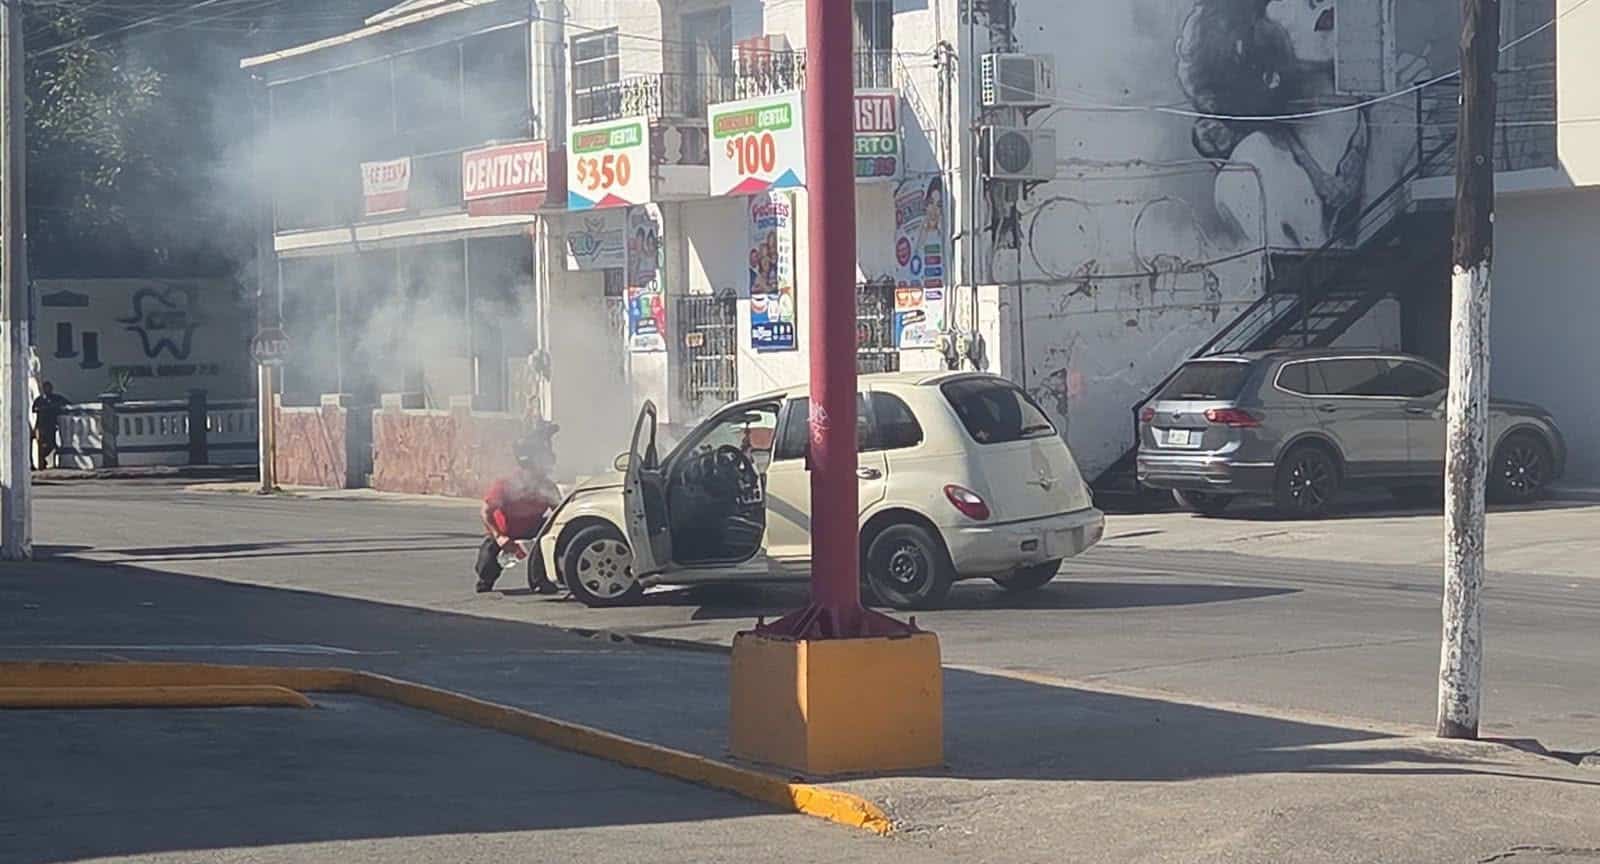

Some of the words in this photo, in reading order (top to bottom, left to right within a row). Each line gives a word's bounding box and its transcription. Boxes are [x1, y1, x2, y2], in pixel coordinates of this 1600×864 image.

[854, 98, 894, 130] ISTA
[726, 132, 775, 175] $100
[857, 136, 894, 153] RTO
[466, 149, 543, 192] DENTISTA
[577, 153, 631, 190] $350
[255, 339, 290, 355] ALTO
